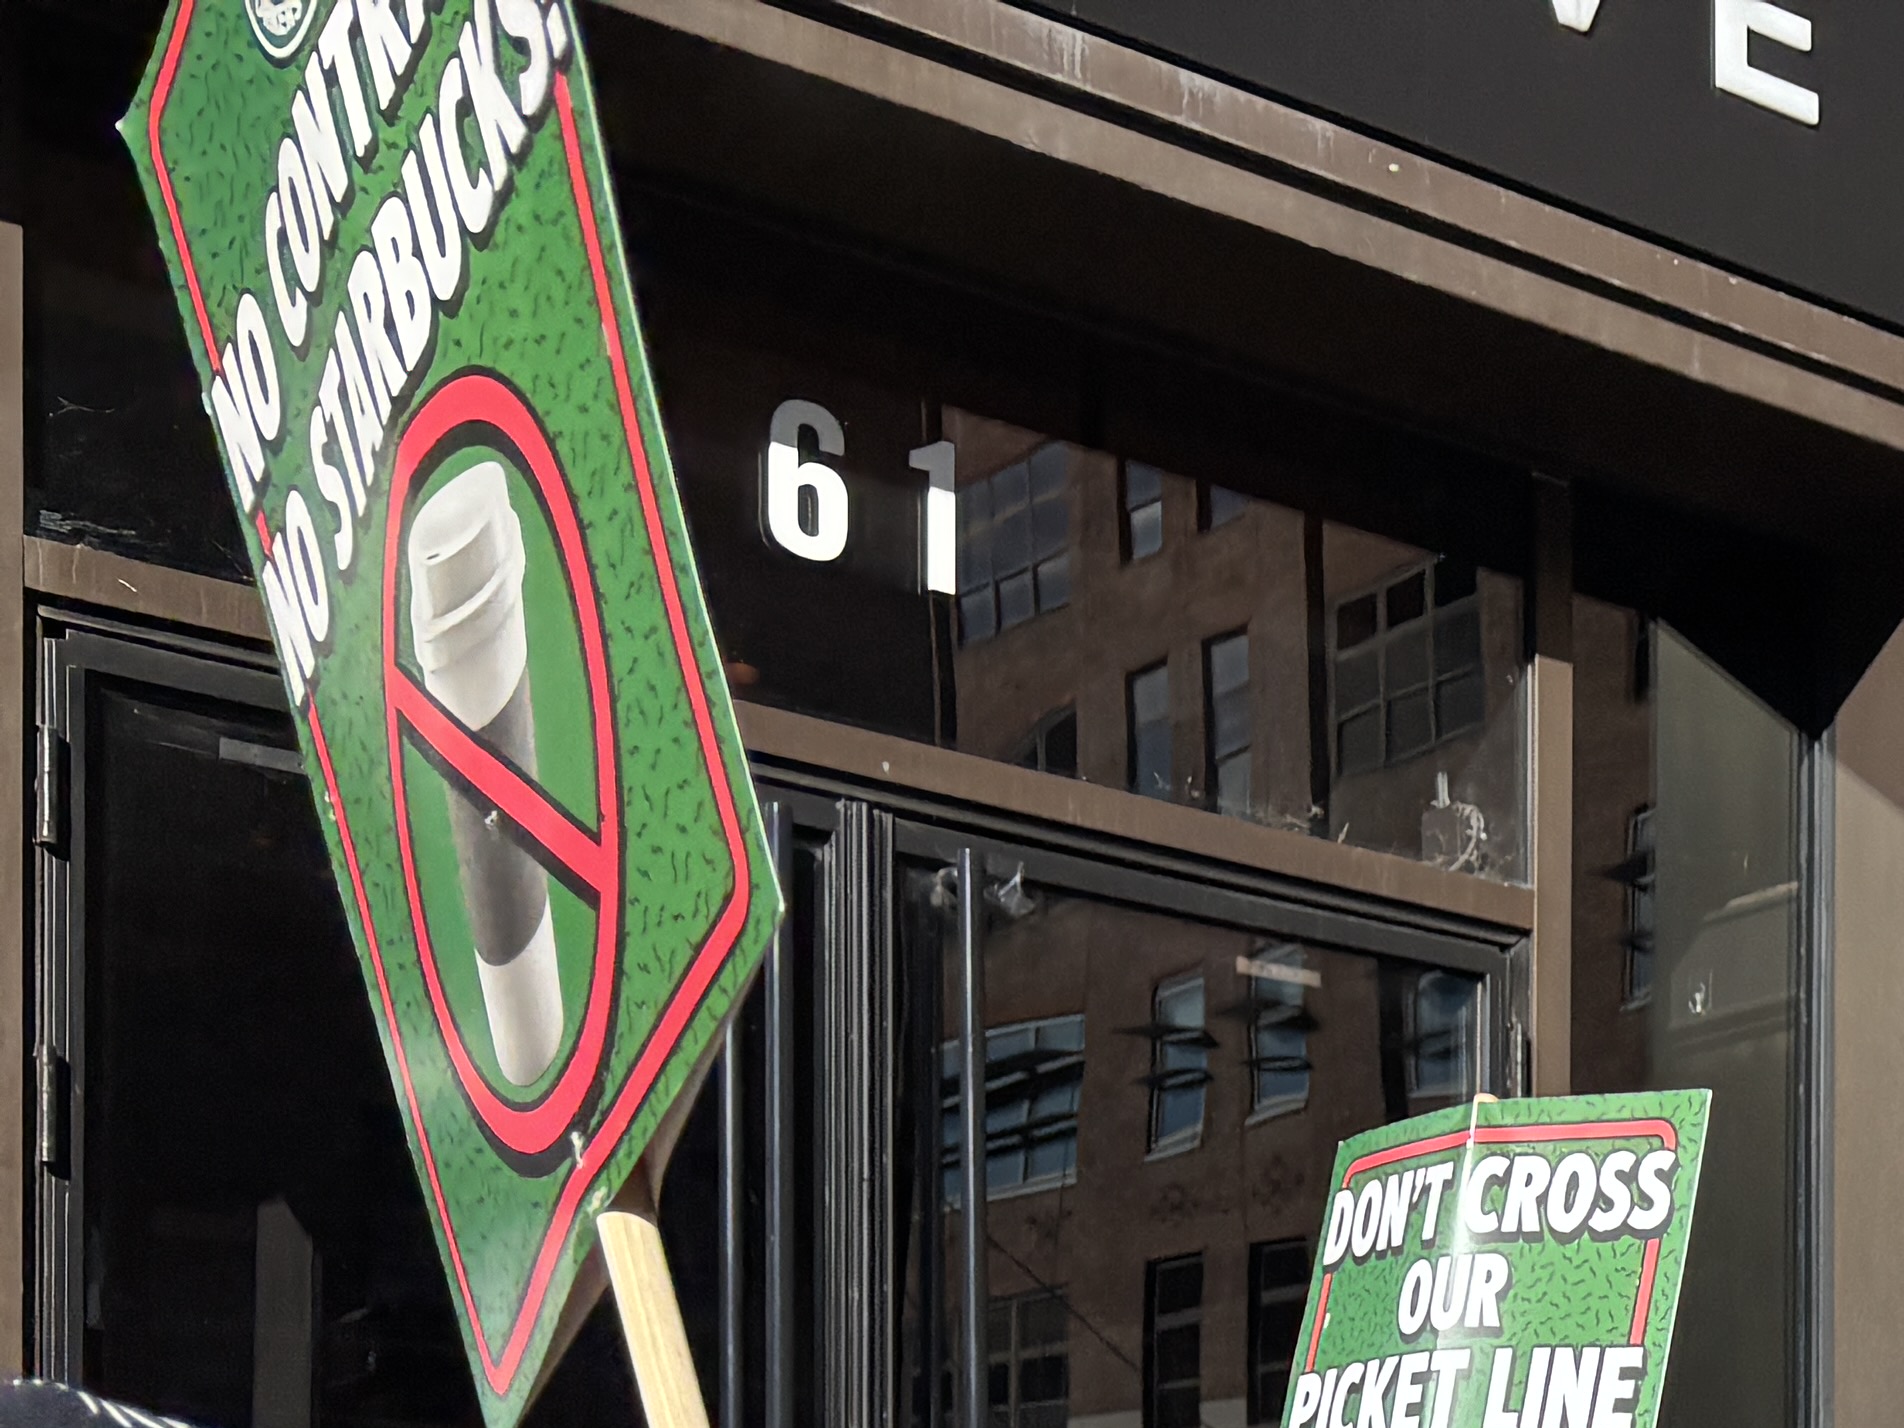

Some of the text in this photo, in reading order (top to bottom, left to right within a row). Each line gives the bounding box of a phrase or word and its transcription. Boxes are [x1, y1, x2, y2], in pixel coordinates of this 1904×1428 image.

[211, 293, 281, 512] NO
[265, 0, 424, 347] CONTR
[262, 490, 328, 707] NO
[1323, 1149, 1676, 1267] DON'T CROSS
[1397, 1252, 1509, 1336] OUR
